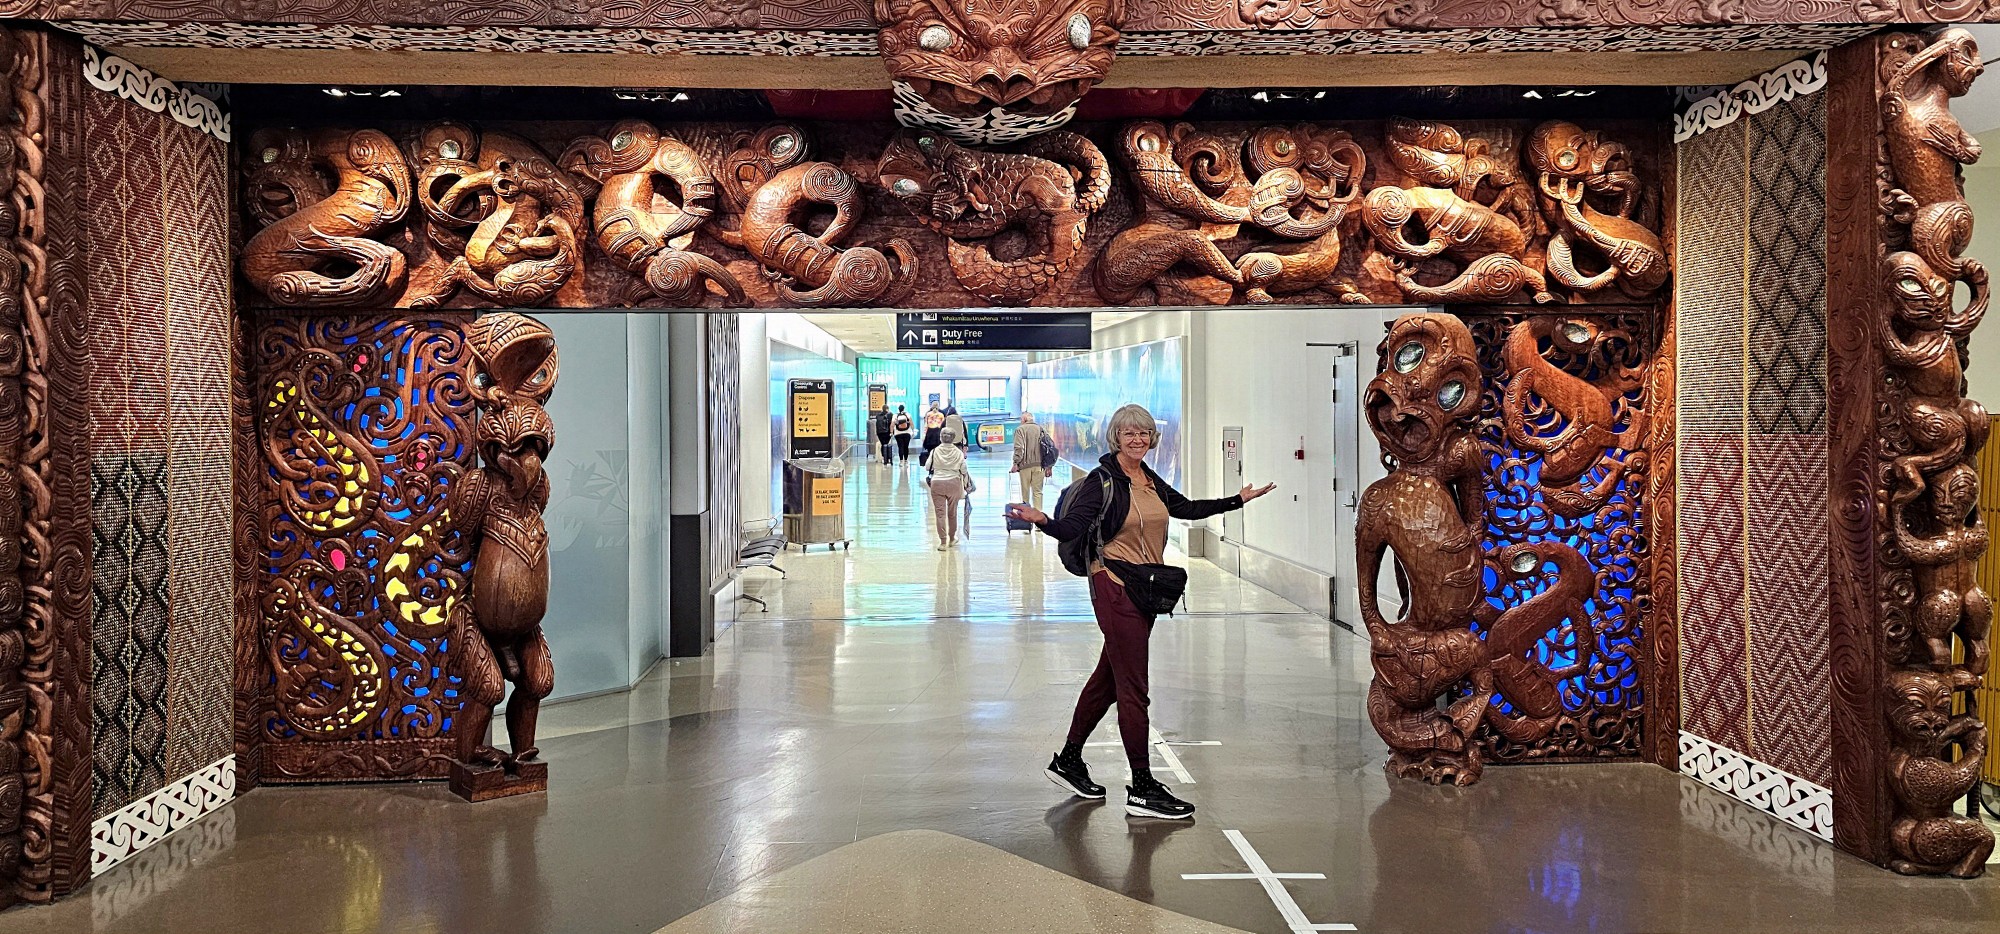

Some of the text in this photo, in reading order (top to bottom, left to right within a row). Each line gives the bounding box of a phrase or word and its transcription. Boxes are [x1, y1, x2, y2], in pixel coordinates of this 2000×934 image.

[942, 329, 983, 339] Duty Free
[1129, 795, 1146, 805] HOKA
